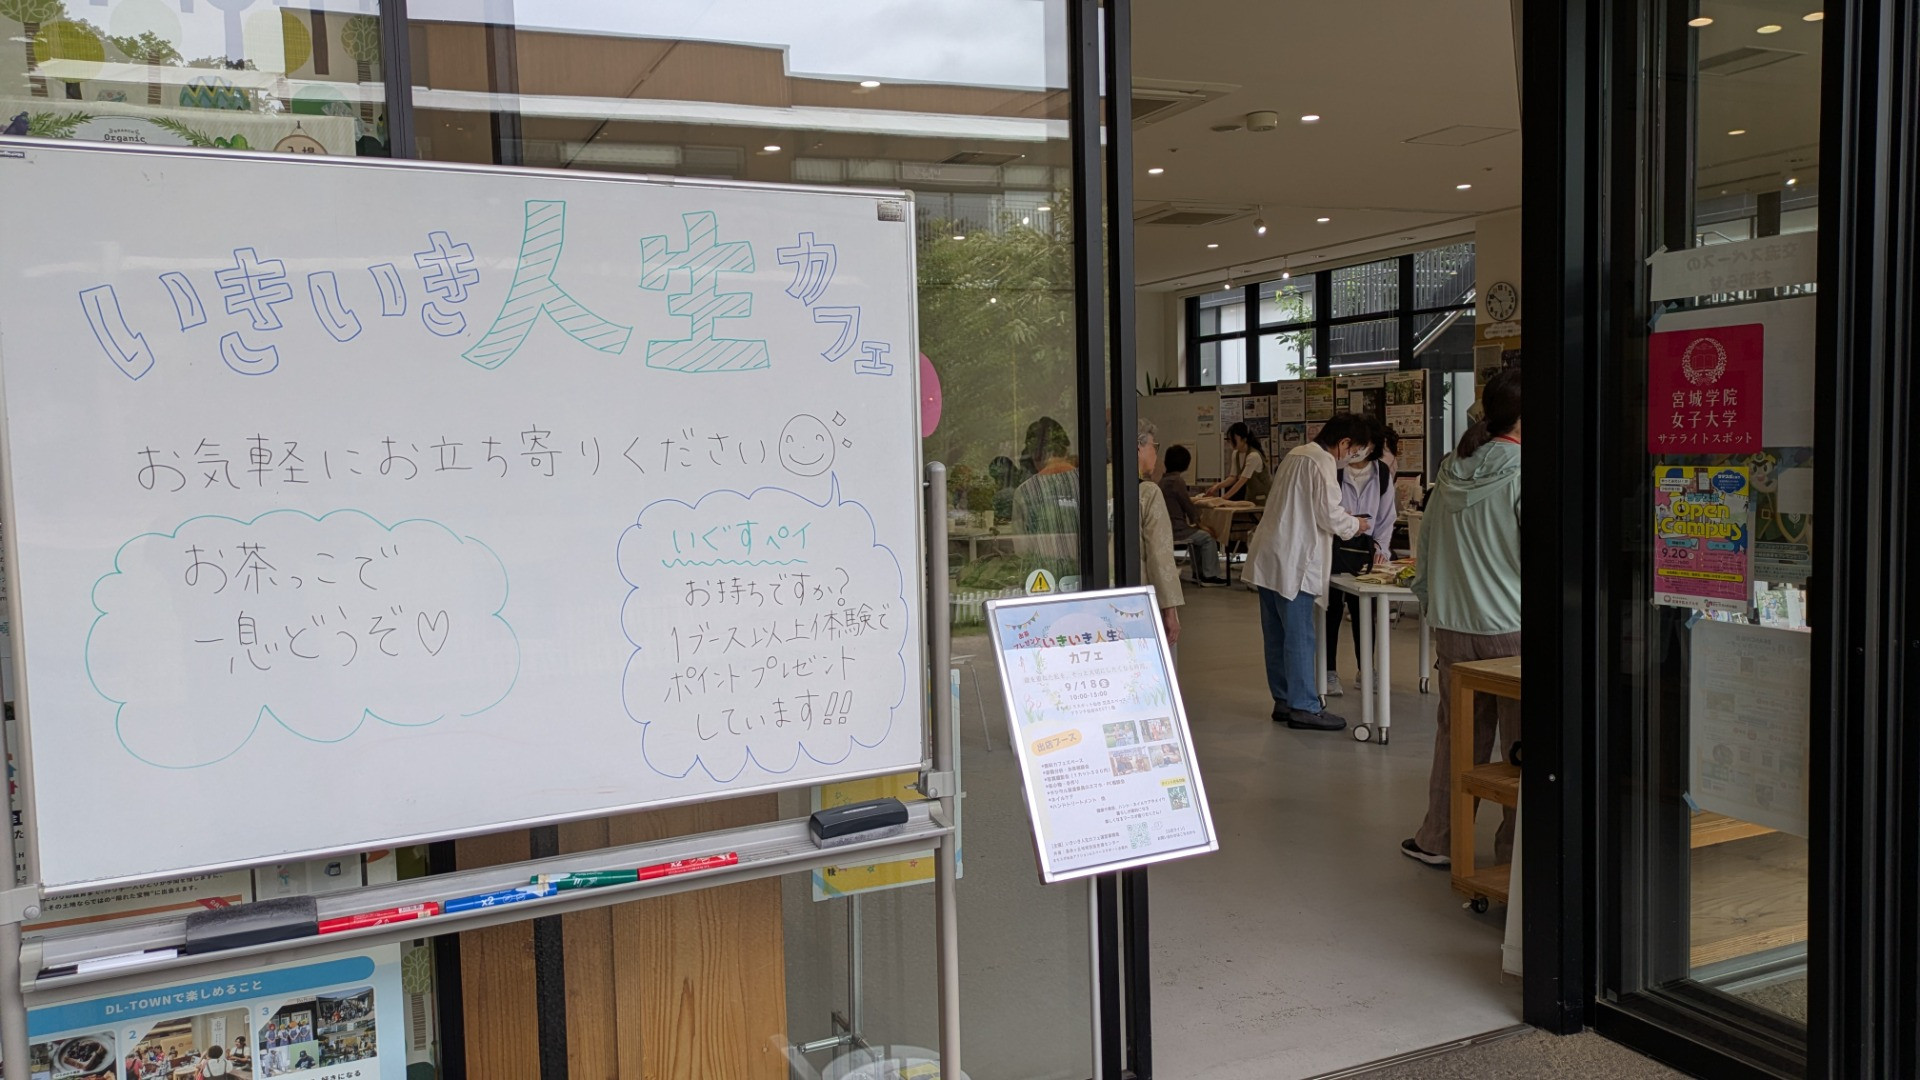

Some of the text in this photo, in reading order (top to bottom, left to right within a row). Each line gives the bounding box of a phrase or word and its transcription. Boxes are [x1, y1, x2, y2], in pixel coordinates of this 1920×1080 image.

[104, 133, 146, 143] Organic
[1671, 388, 1738, 409] 宮城学院
[1671, 409, 1738, 429] 女子大学
[1657, 431, 1753, 445] サテライトスポット
[138, 423, 766, 492] お気軽にお立ち寄りください
[1672, 501, 1730, 519] Open
[673, 519, 812, 555] いぐすペイ
[1660, 517, 1742, 541] Campus
[184, 542, 399, 594] お茶っこで
[685, 566, 850, 608] お持ちですか?
[194, 604, 404, 674] 一息どうぞ
[1041, 629, 1119, 650] いきいき人生
[1068, 650, 1104, 665] カフェ
[664, 645, 856, 703] ポイントプレゼント
[1069, 690, 1108, 701] 10:00-15:00
[1036, 731, 1078, 753] 出店ブース
[105, 979, 263, 1016] DL-TOWNで楽しめること
[261, 1006, 270, 1016] 3
[128, 1030, 138, 1040] 2
